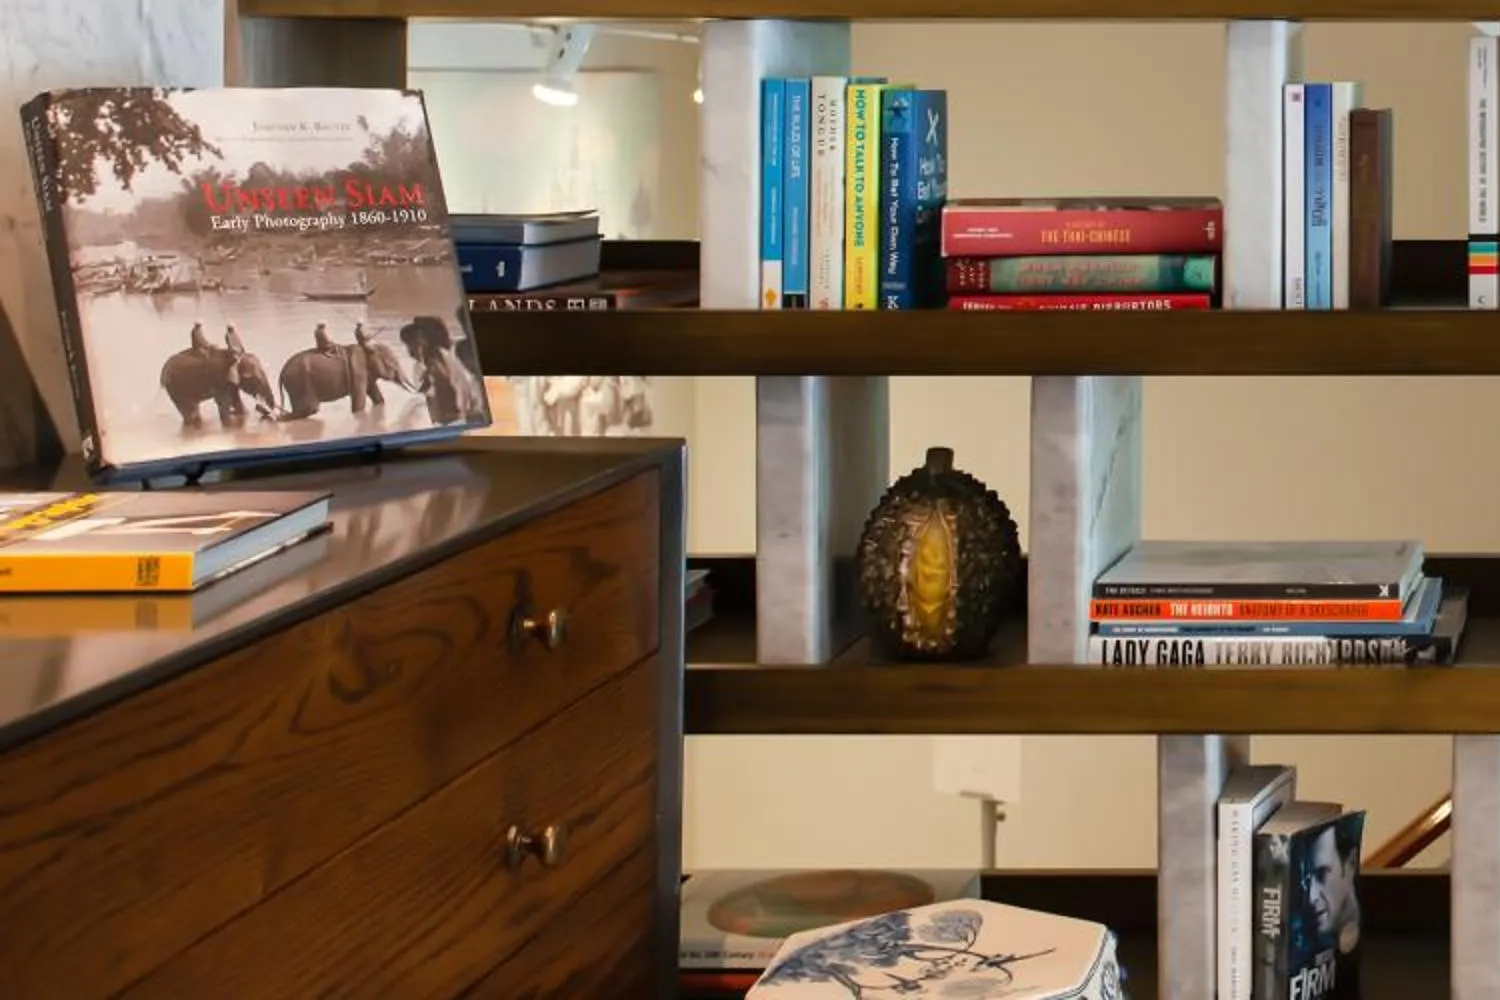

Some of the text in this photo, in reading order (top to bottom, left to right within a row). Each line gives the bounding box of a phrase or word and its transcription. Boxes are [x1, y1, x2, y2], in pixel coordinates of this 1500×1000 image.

[817, 95, 826, 157] TONGUE
[854, 89, 866, 248] HOW TO TALK TO ANYONE
[343, 173, 424, 210] SIAM
[209, 208, 427, 233] Early Photography 1860-1910
[1101, 639, 1150, 665] LADY
[1156, 639, 1205, 665] GAGA
[1214, 639, 1275, 665] TERRY
